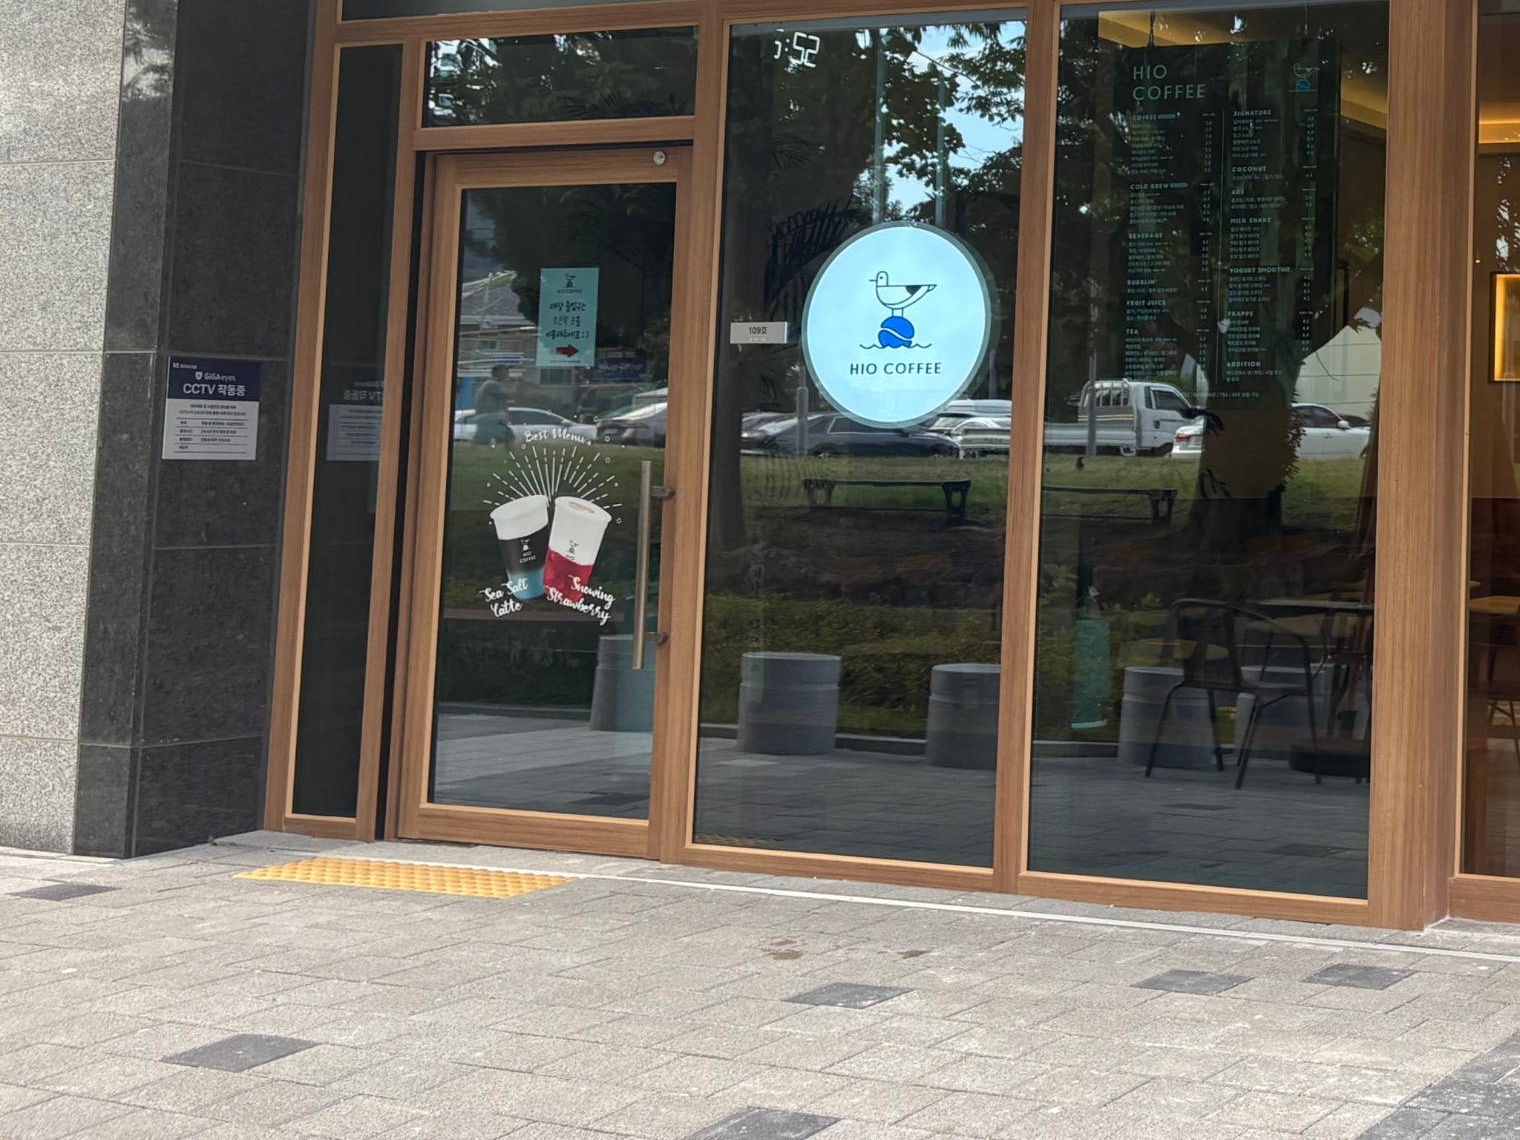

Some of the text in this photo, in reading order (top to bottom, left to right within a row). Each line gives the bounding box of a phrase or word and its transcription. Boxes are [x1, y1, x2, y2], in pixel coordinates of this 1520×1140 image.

[1132, 64, 1168, 80] HIO
[1132, 83, 1206, 101] COFFEE
[1233, 109, 1272, 117] SIGNATURE
[849, 362, 943, 375] HIO COFFEE
[183, 383, 246, 397] CCTV 작동중
[523, 427, 587, 443] Best Menu
[479, 577, 529, 602] Sea Salt
[544, 585, 611, 626] Strawberry
